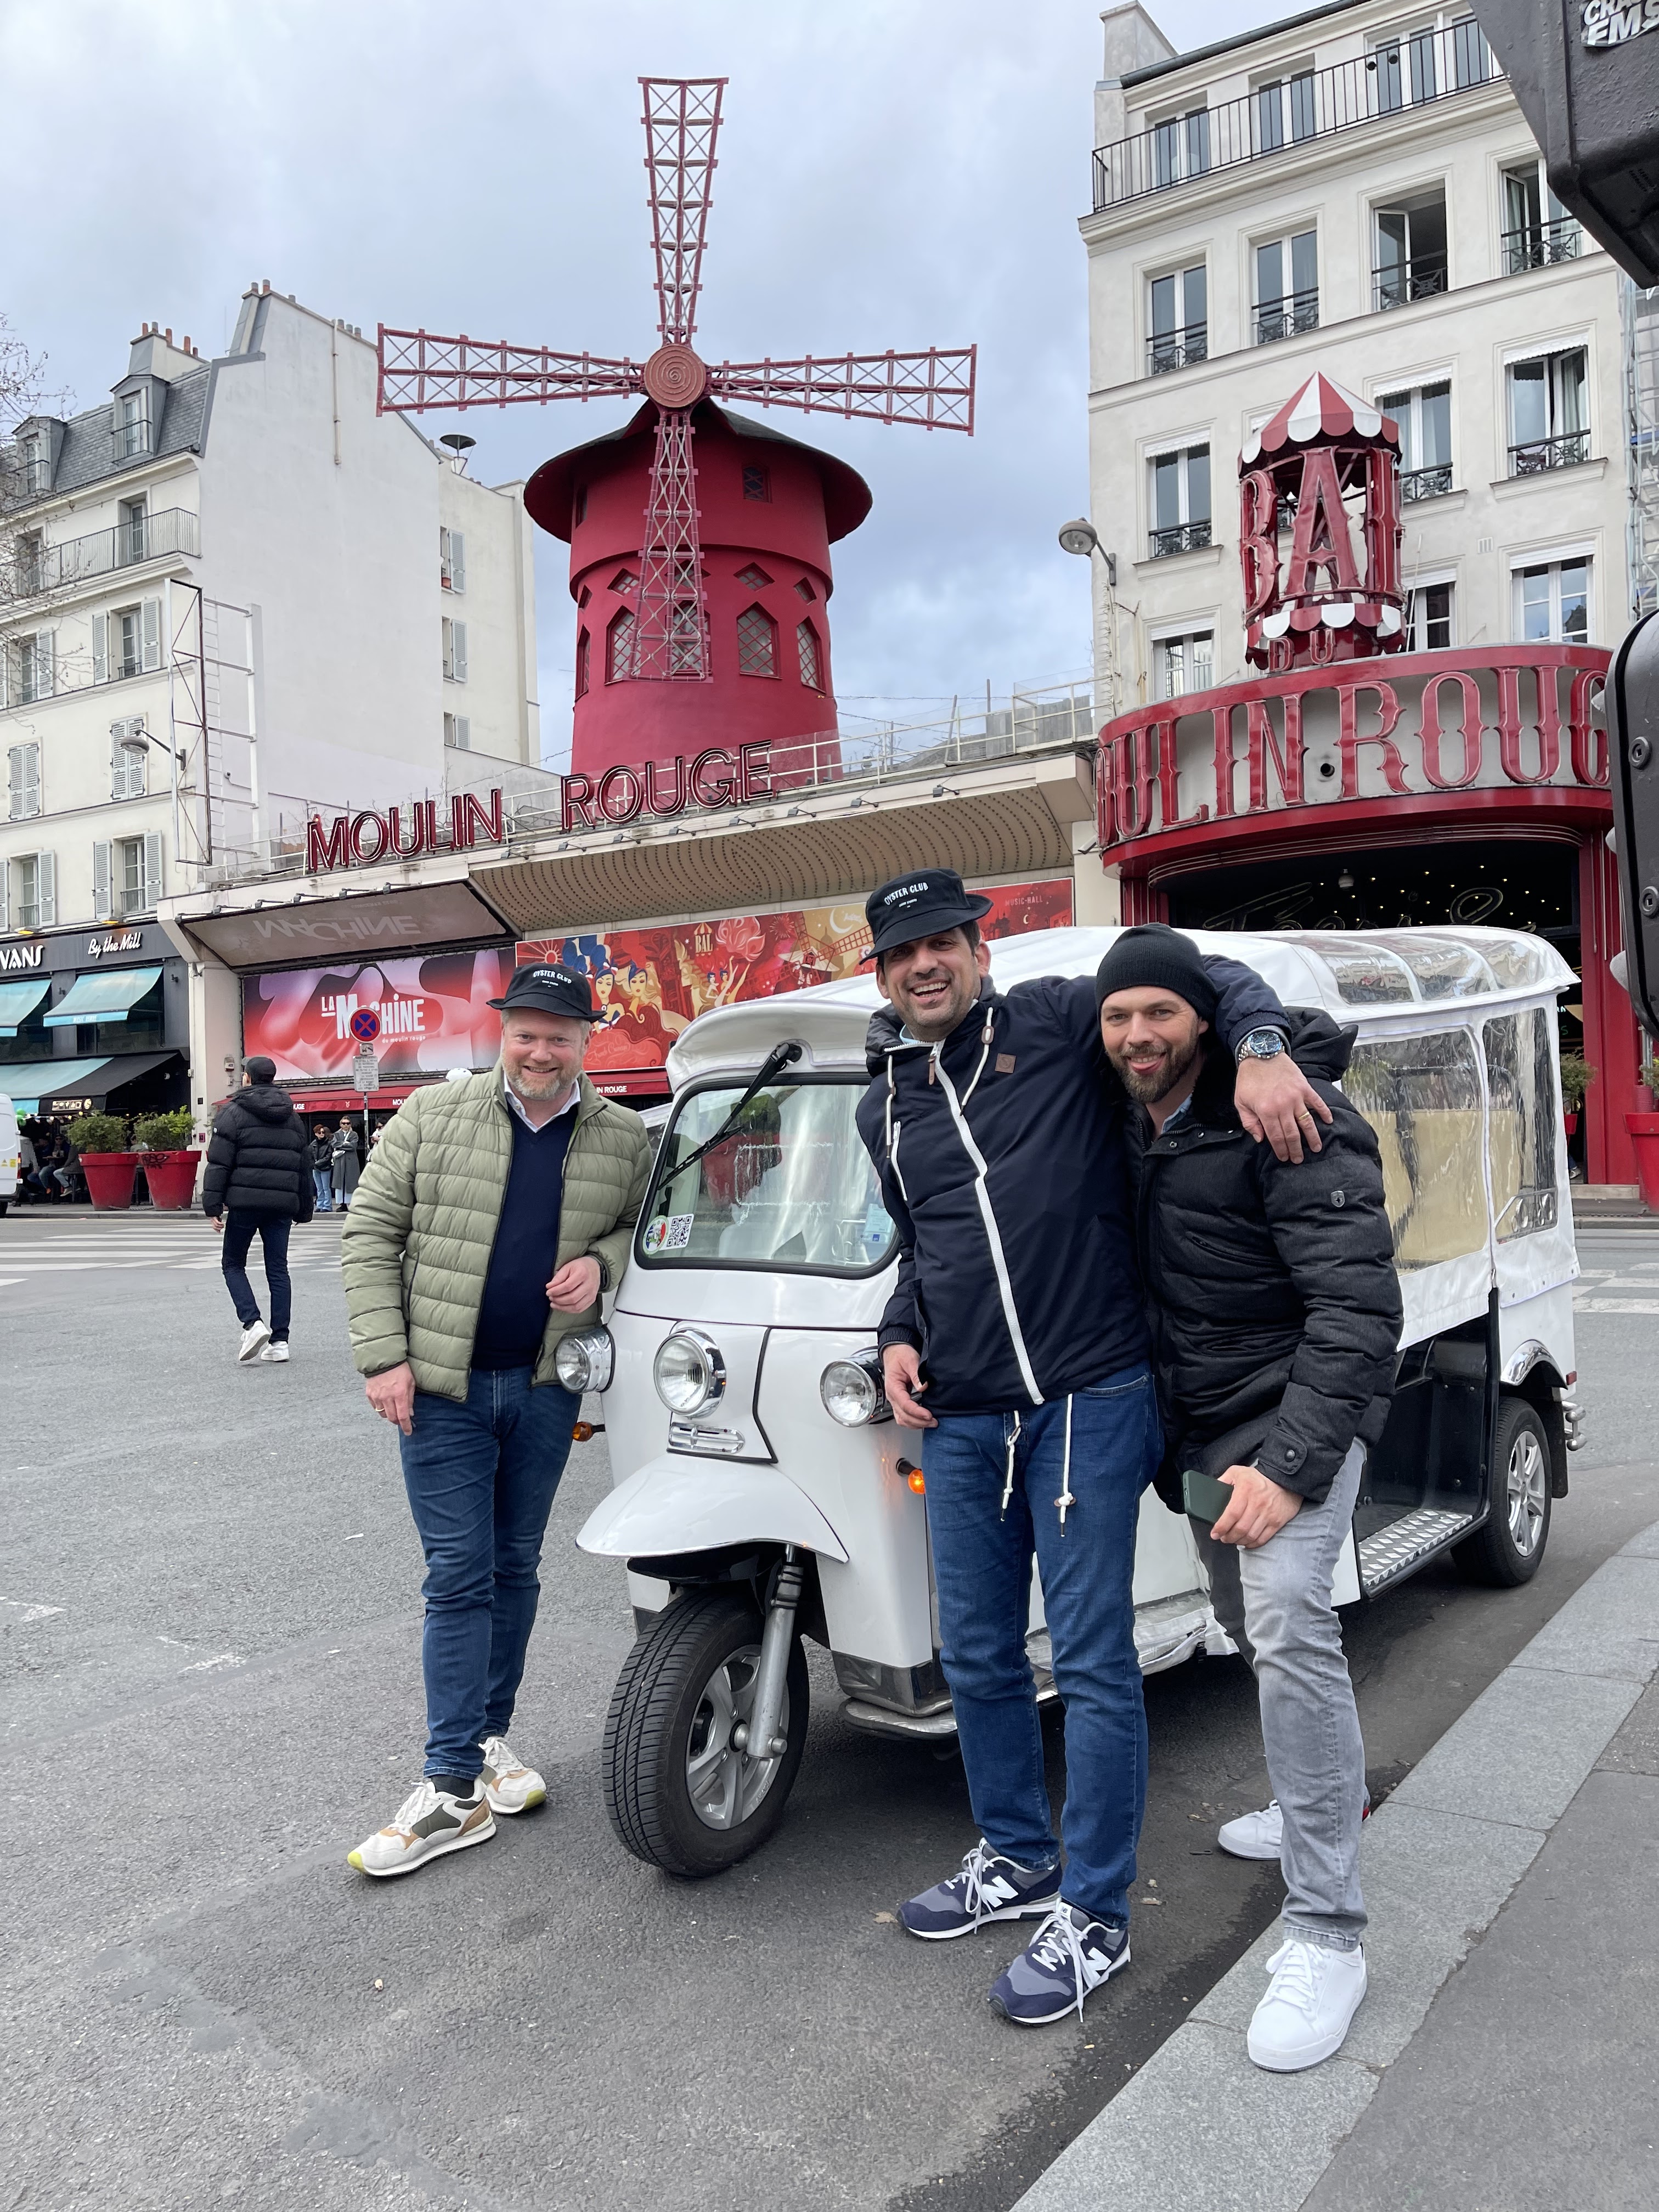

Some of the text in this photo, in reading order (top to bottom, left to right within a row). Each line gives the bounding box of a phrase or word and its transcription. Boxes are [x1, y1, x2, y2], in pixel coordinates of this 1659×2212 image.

[1267, 629, 1335, 672] DU
[307, 739, 776, 872] MOULIN ROUGE
[884, 887, 909, 905] OYSTER
[910, 882, 929, 893] CLUB
[1005, 895, 1043, 906] MUSIC-HALL
[88, 932, 141, 958] By the Mill
[695, 934, 713, 953] BAL
[533, 969, 572, 984] OYSTER CLUB
[321, 993, 425, 1040] LA MHiNE
